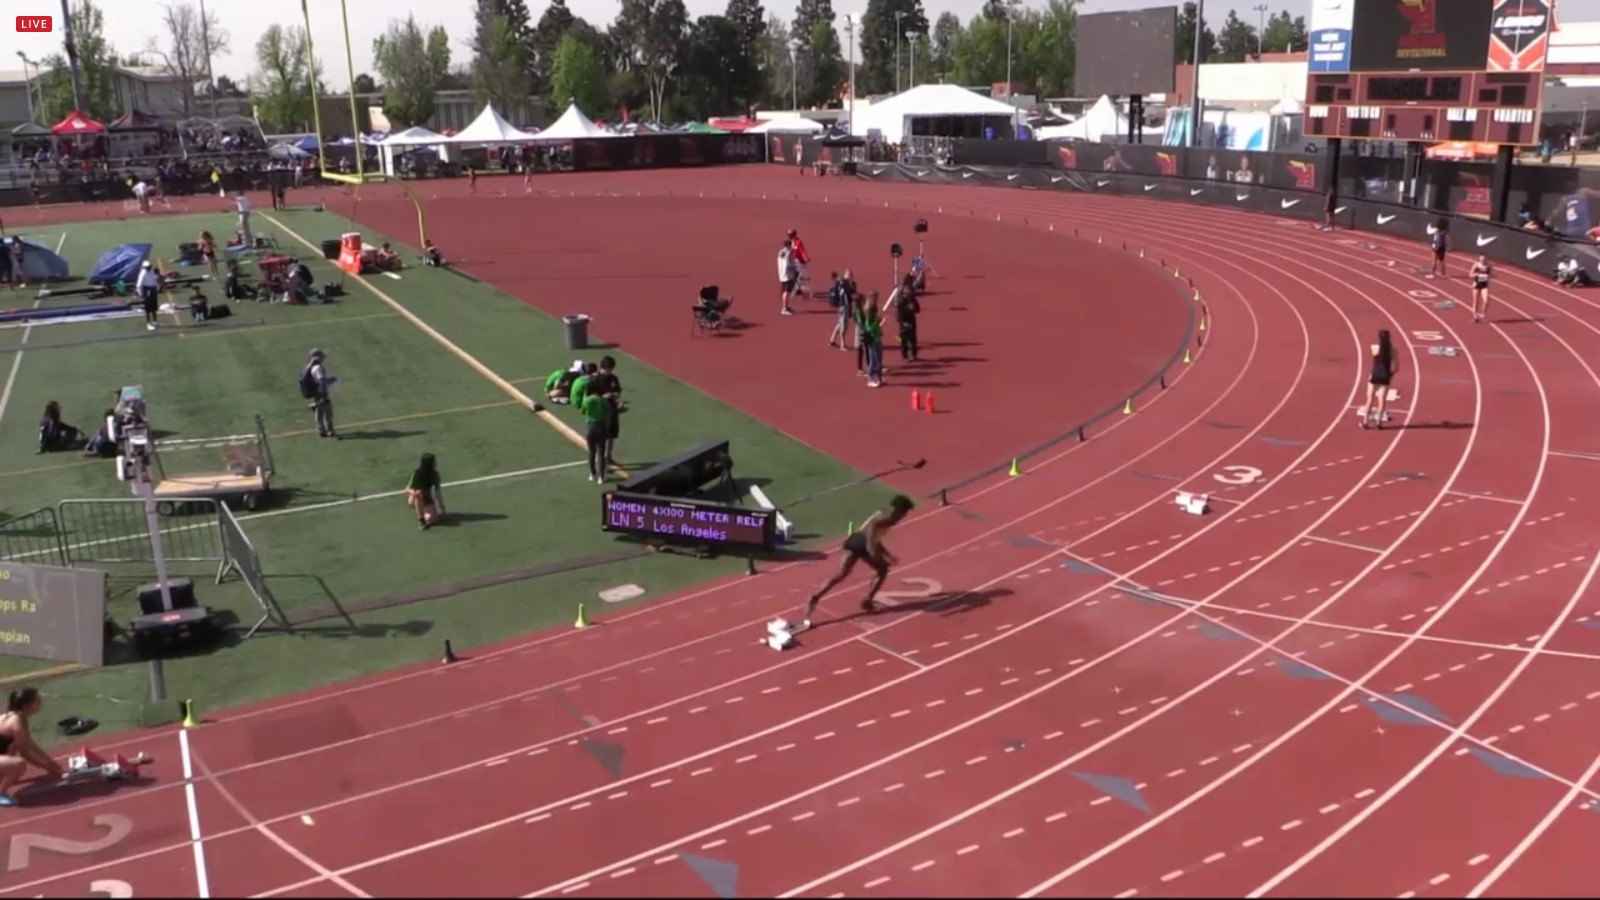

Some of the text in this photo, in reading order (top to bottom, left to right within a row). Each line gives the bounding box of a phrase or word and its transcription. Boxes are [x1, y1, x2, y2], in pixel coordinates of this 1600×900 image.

[1412, 330, 1444, 341] 5
[1213, 465, 1263, 485] 3
[608, 501, 646, 514] WOMEN
[653, 506, 685, 518] 4X100
[691, 510, 729, 523] METER
[611, 512, 727, 541] LN 5 Los Angeles
[874, 577, 942, 606] 2
[21, 599, 36, 613] Ra
[7, 812, 133, 872] 2
